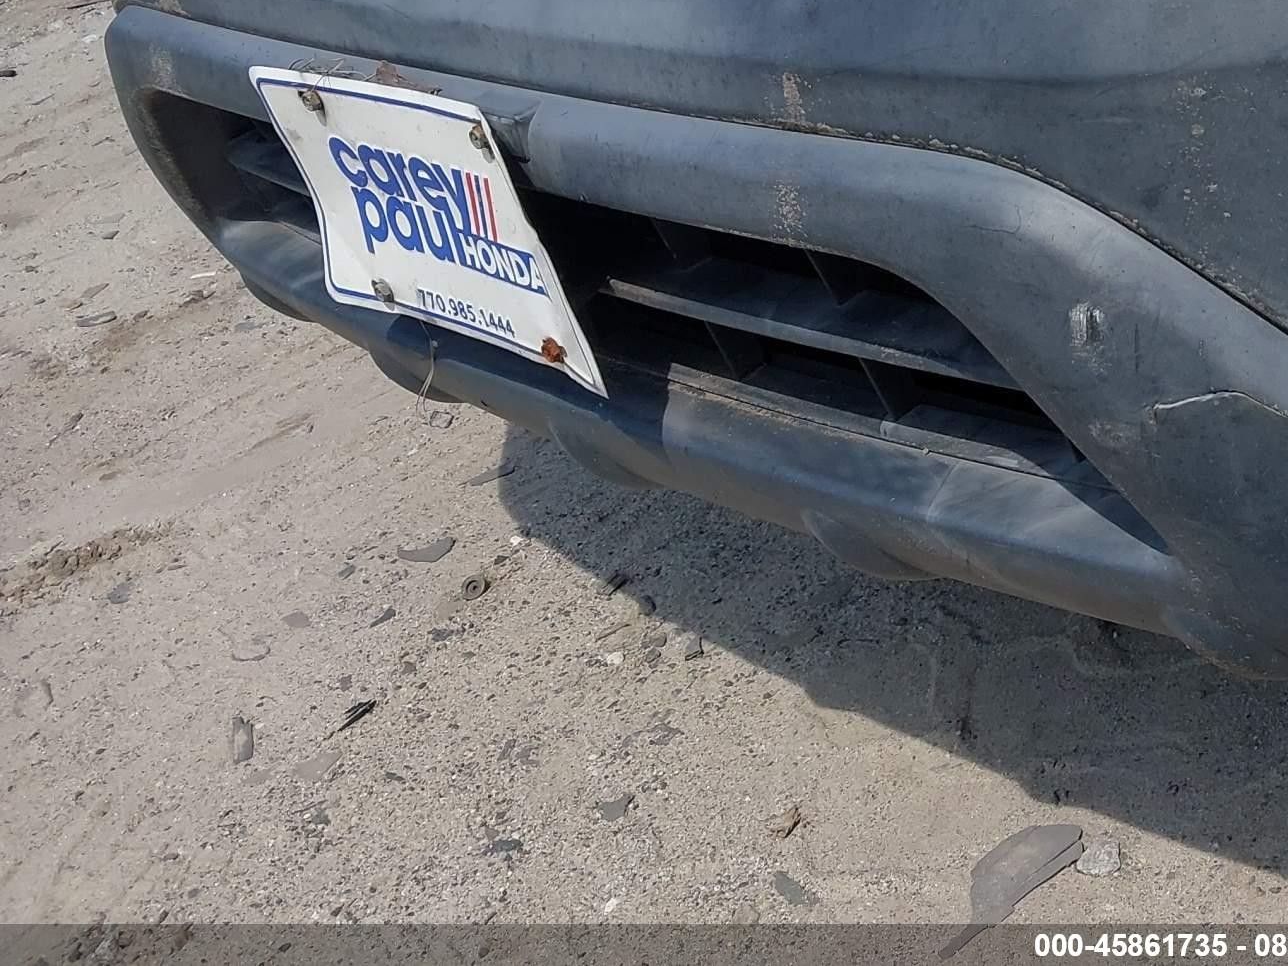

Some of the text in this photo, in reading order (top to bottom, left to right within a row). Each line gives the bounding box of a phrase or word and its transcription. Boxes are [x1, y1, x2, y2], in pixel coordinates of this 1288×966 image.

[329, 137, 472, 234] carey
[351, 187, 466, 266] paul
[464, 236, 545, 289] HONDA
[417, 288, 515, 337] 770.985.1444
